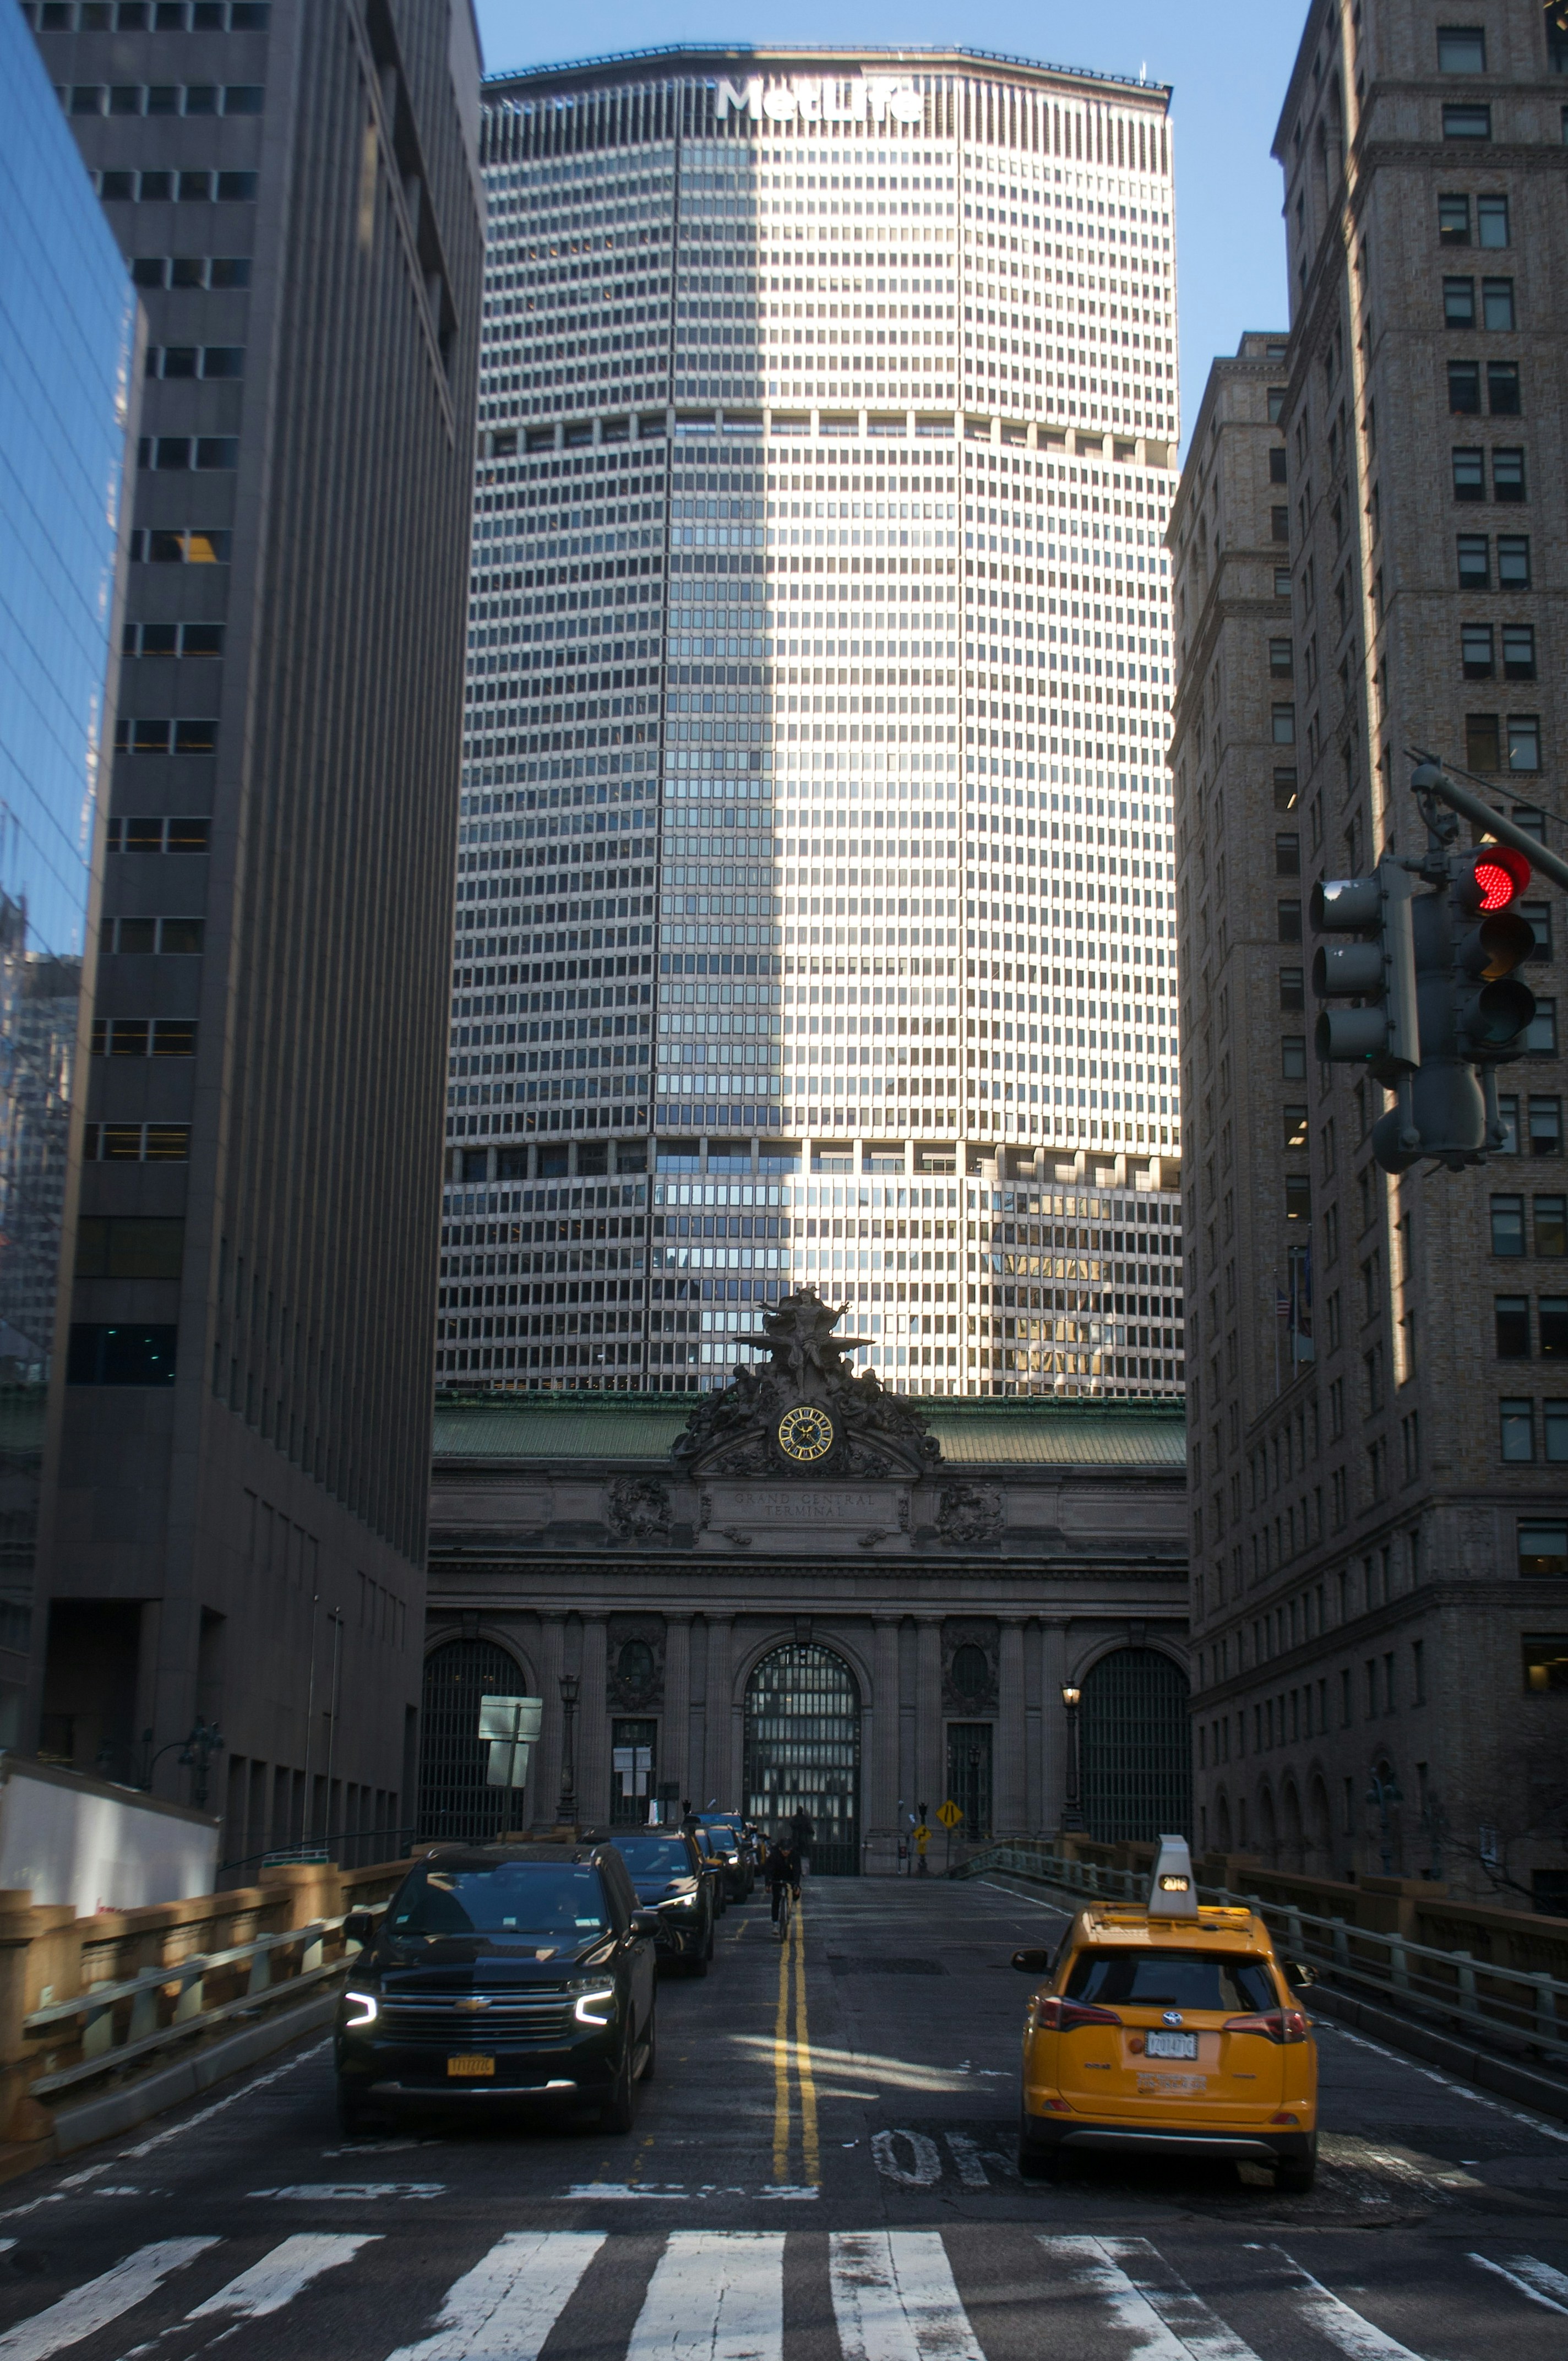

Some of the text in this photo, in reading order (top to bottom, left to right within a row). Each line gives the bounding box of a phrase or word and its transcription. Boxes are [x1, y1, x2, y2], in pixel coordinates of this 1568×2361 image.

[717, 75, 923, 123] MetLife
[734, 1493, 875, 1505] GRAND CENTRAL
[764, 1505, 845, 1516] TERMINAL
